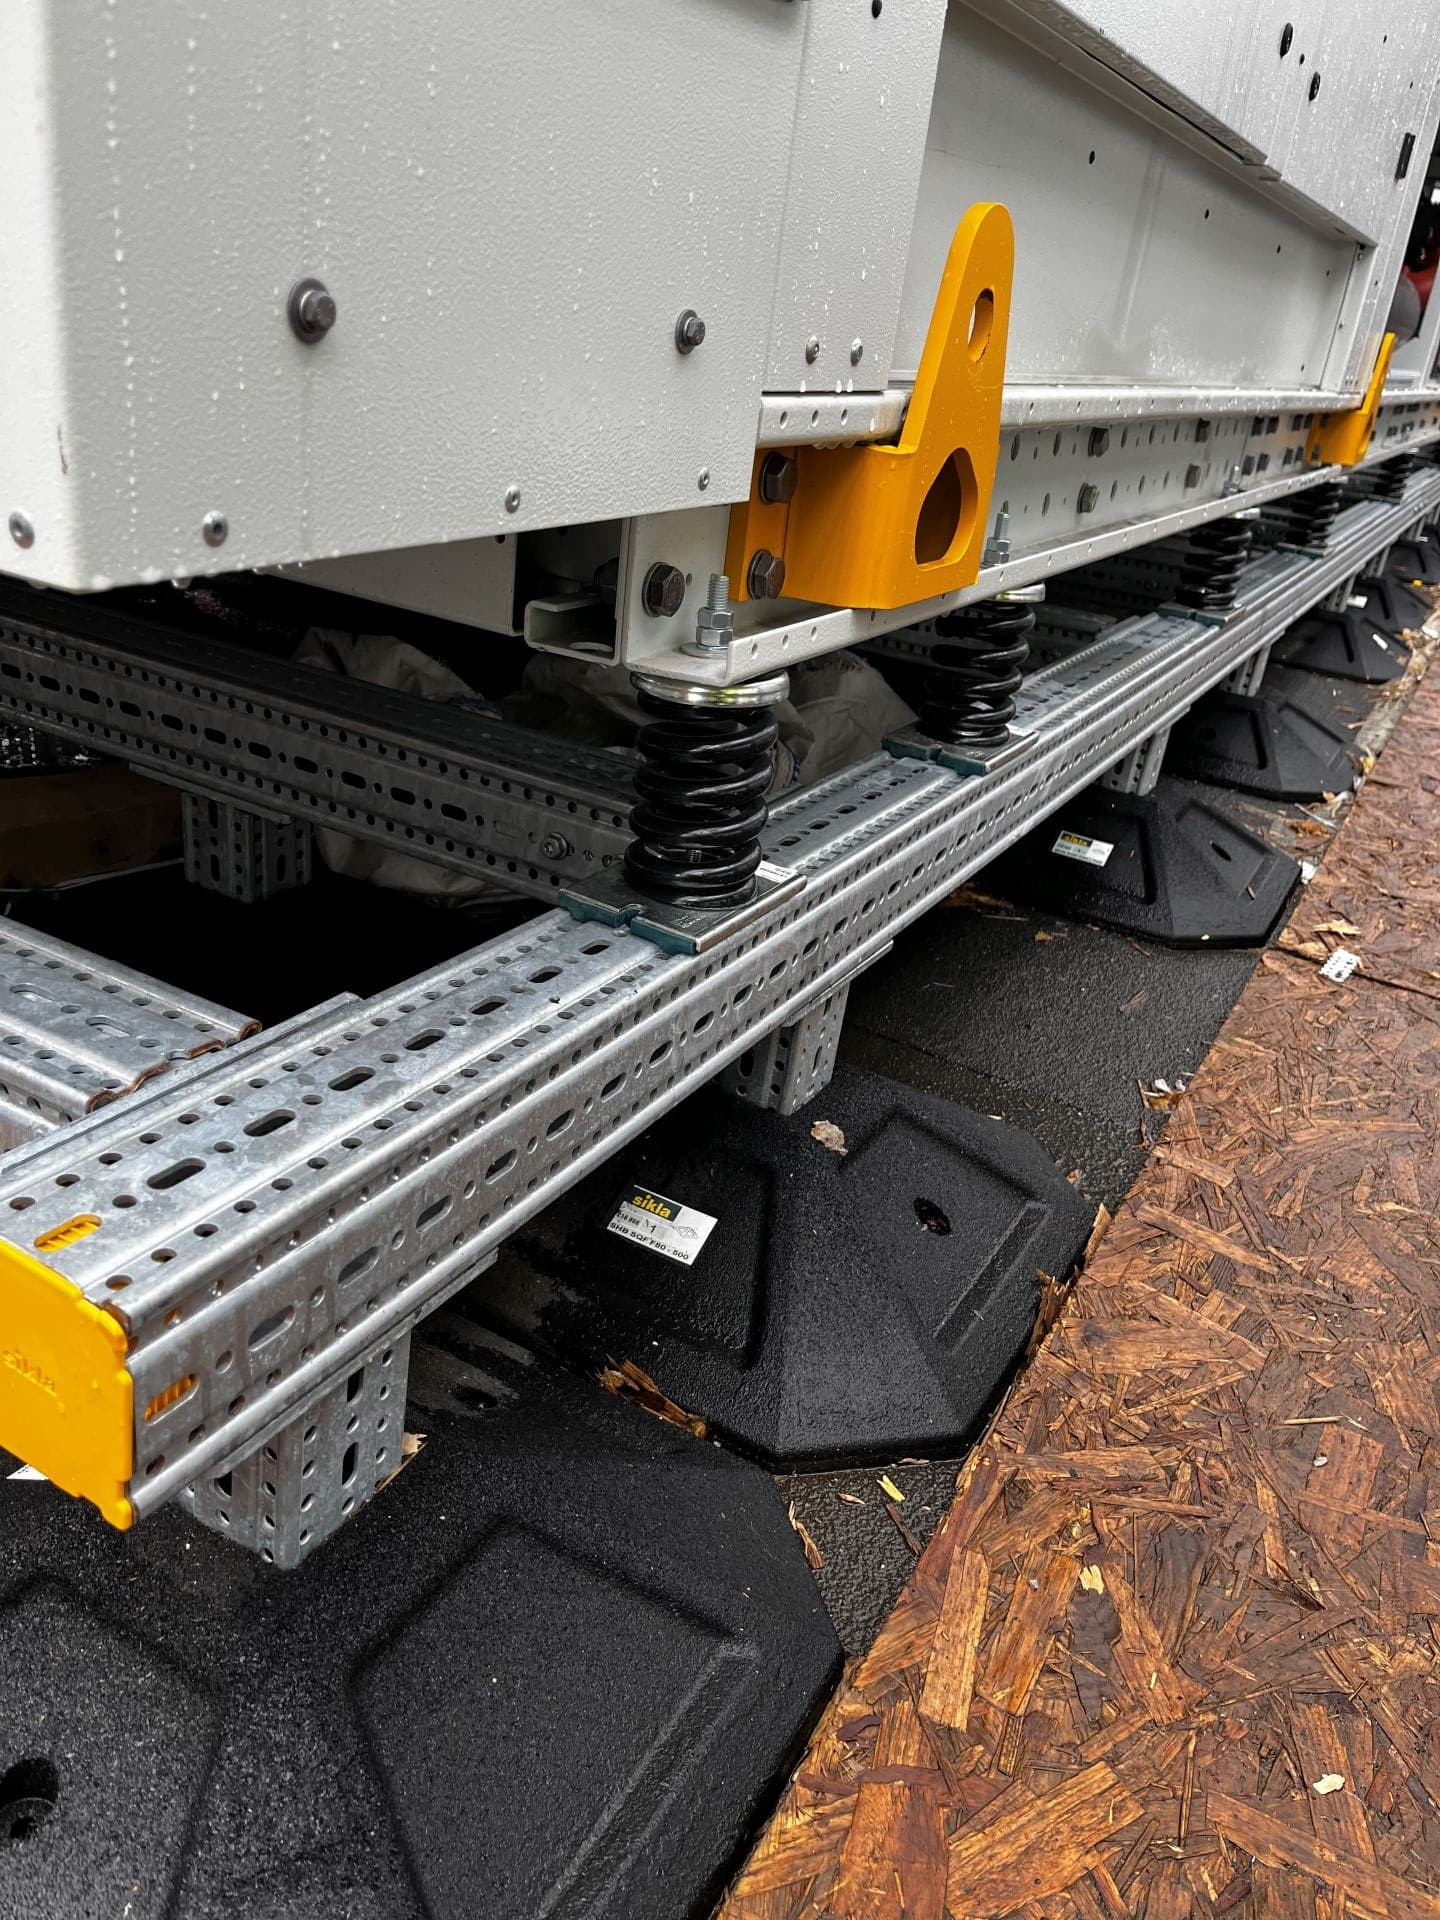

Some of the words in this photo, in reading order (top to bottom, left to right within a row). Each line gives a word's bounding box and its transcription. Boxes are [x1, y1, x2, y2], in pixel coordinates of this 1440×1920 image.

[632, 1194, 671, 1219] sikla
[610, 1222, 629, 1234] SHB
[630, 1231, 648, 1242] SQF
[649, 1239, 666, 1250] F80
[672, 1250, 689, 1260] 500
